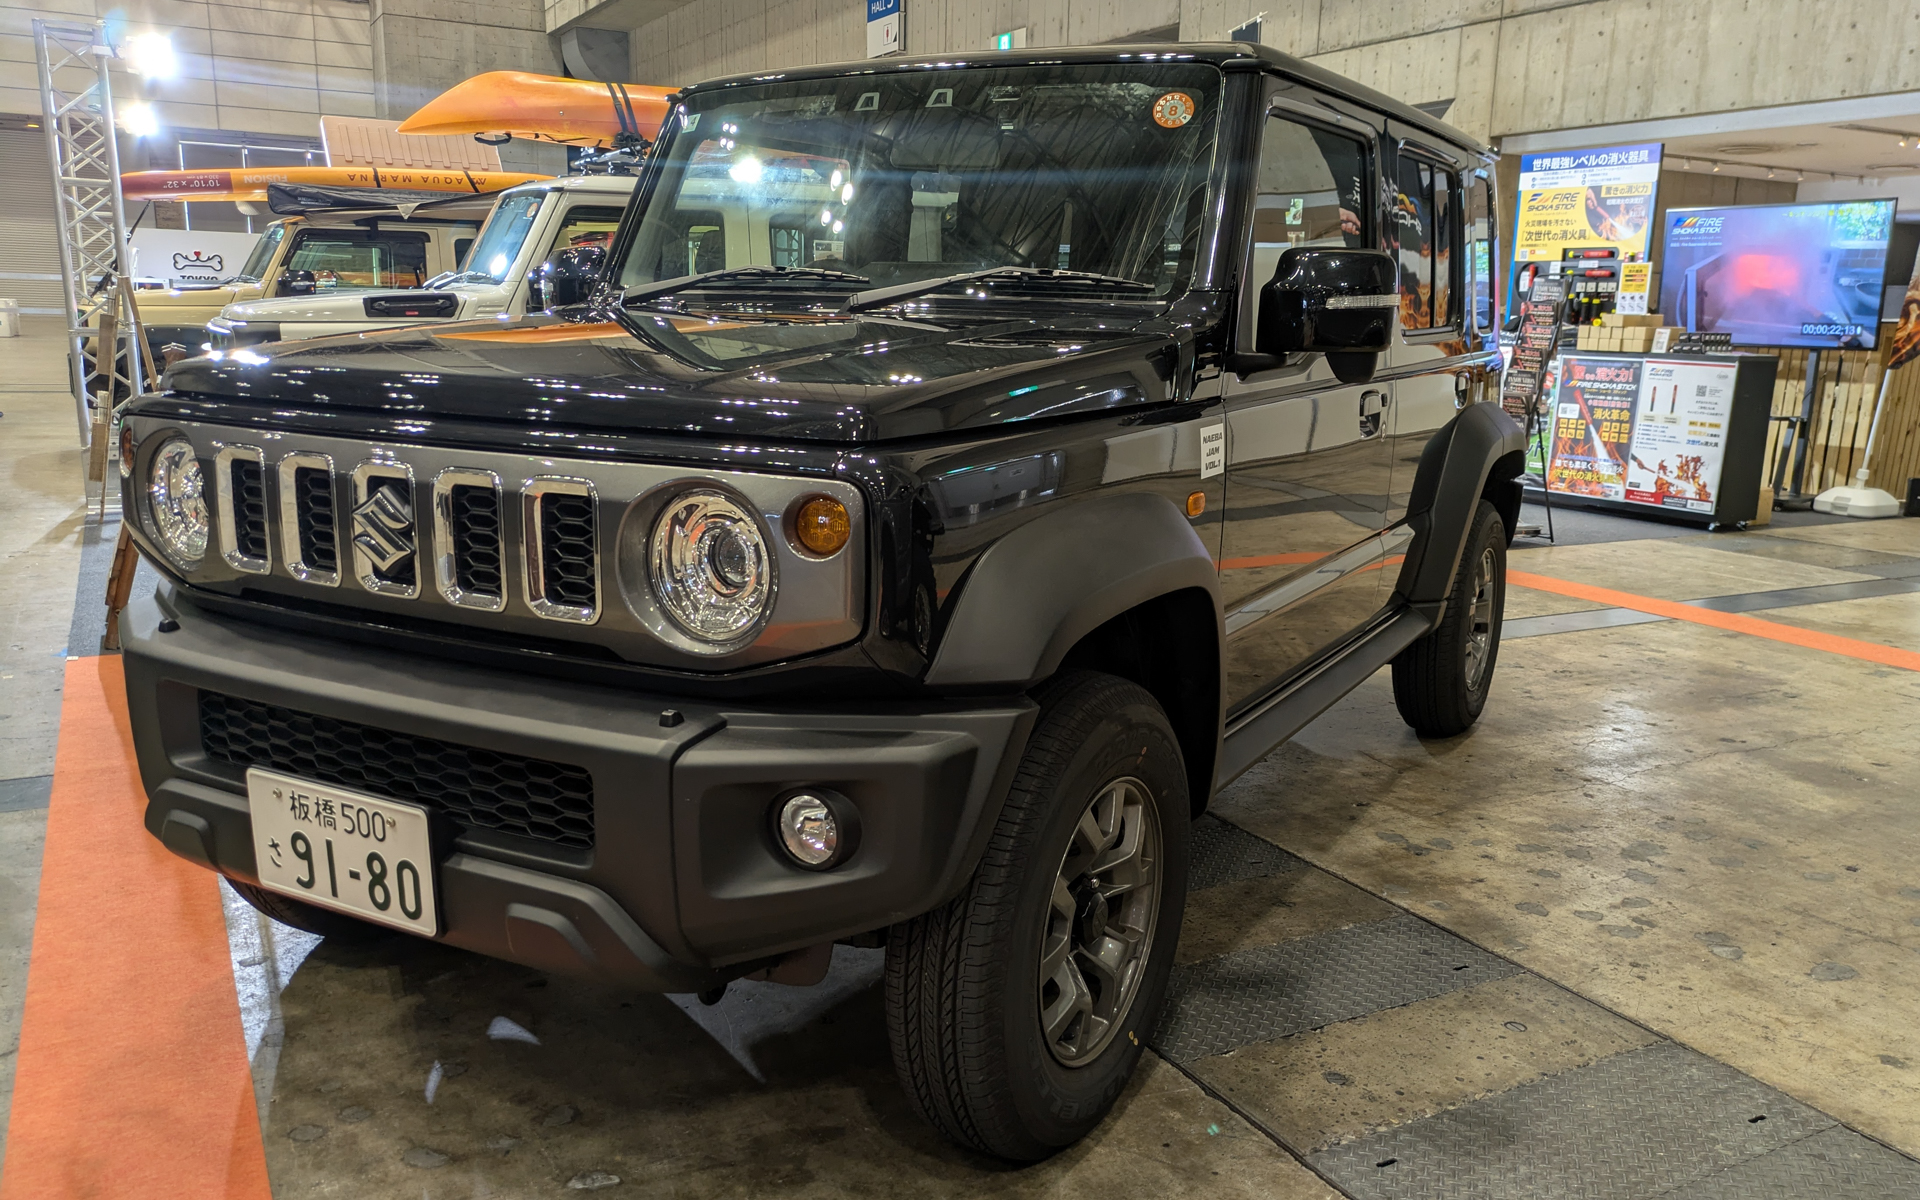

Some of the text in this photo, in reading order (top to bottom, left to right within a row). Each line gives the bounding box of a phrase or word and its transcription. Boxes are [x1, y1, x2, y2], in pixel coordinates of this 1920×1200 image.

[871, 0, 886, 14] HALL
[1168, 105, 1178, 116] 8
[1532, 150, 1649, 171] 世界最強レベルの消火器具
[244, 174, 288, 184] FUSION
[421, 175, 464, 185] AQUA
[1551, 192, 1580, 203] FIRE
[1527, 203, 1576, 212] SHOKA STICK
[1695, 217, 1725, 227] FIRE
[1699, 226, 1722, 234] STICK
[1593, 407, 1631, 422] 消火革命
[1203, 432, 1222, 444] NAEBA
[1206, 446, 1220, 457] JAM
[268, 830, 422, 921] さ 91-80
